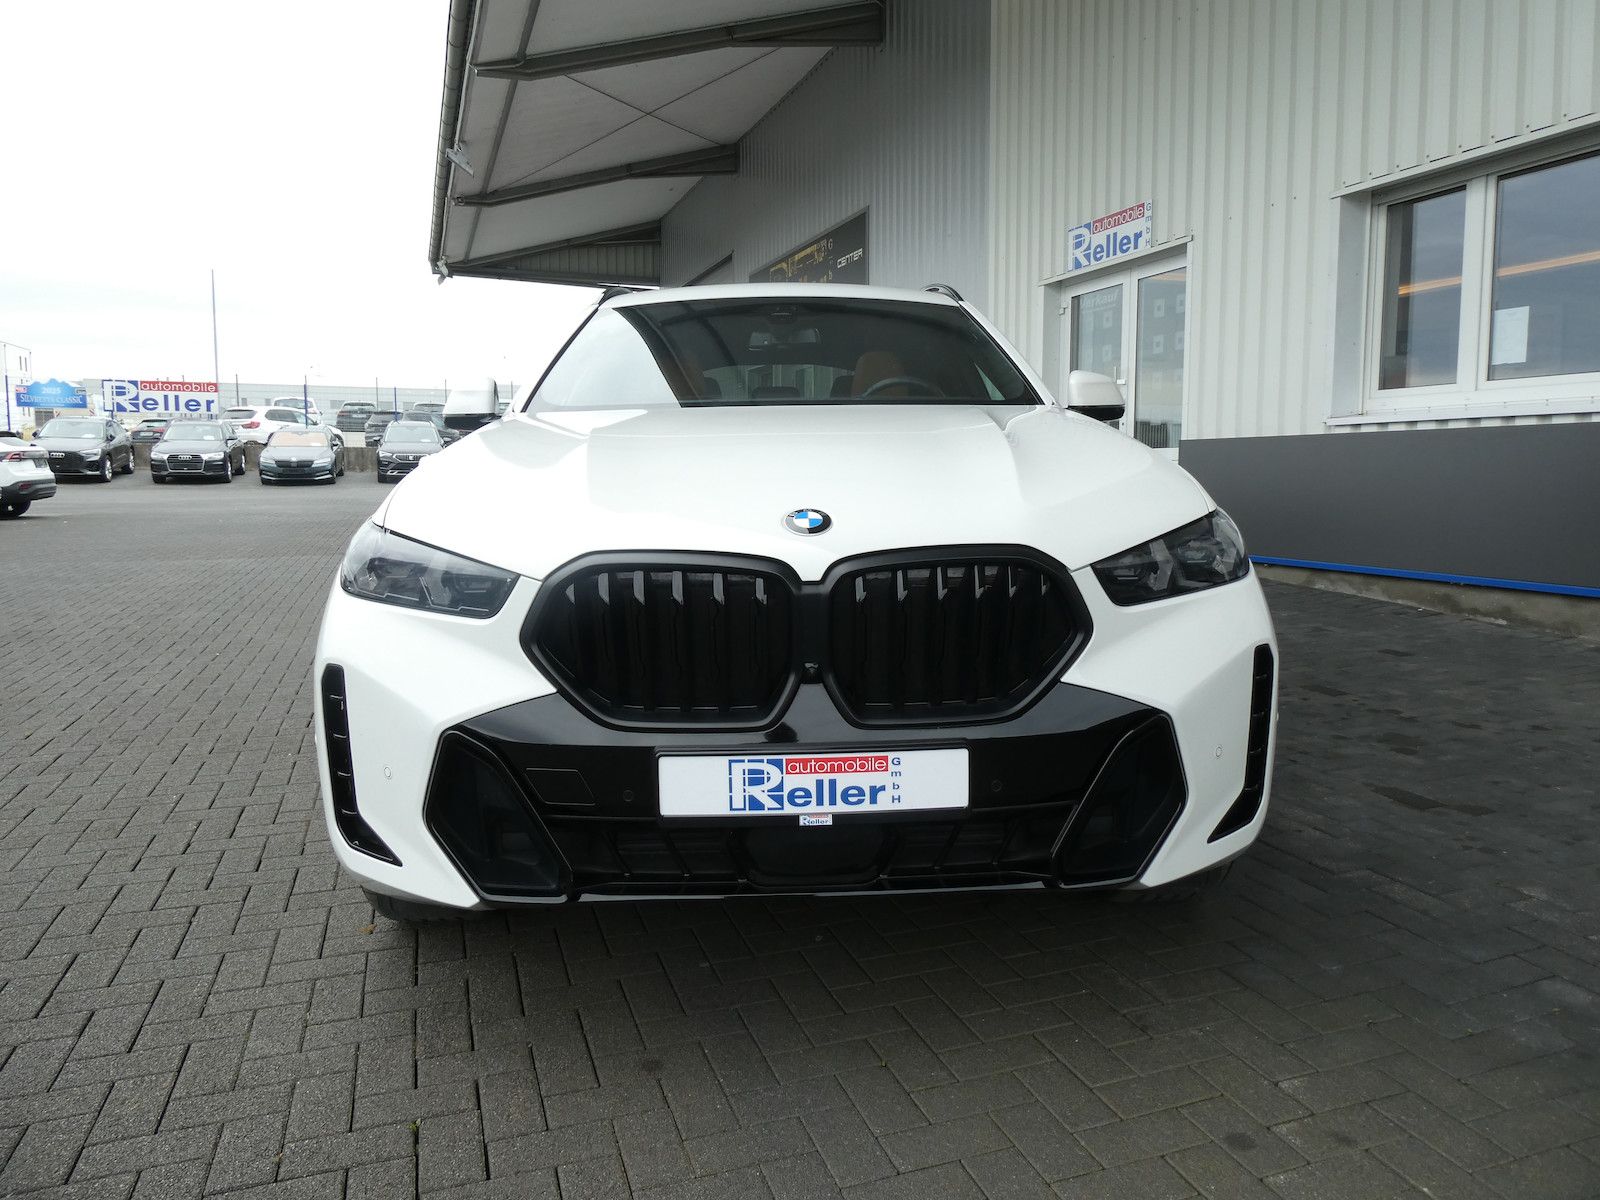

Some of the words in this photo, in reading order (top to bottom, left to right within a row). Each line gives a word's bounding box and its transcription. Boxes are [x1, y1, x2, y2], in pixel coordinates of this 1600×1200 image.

[1093, 206, 1144, 232] automobile
[837, 248, 863, 268] CENTER
[1067, 221, 1143, 272] Reller
[102, 379, 215, 412] Reller
[141, 382, 216, 392] automobile
[788, 758, 887, 773] automobile
[891, 757, 902, 803] GmbH
[728, 758, 886, 811] Reller
